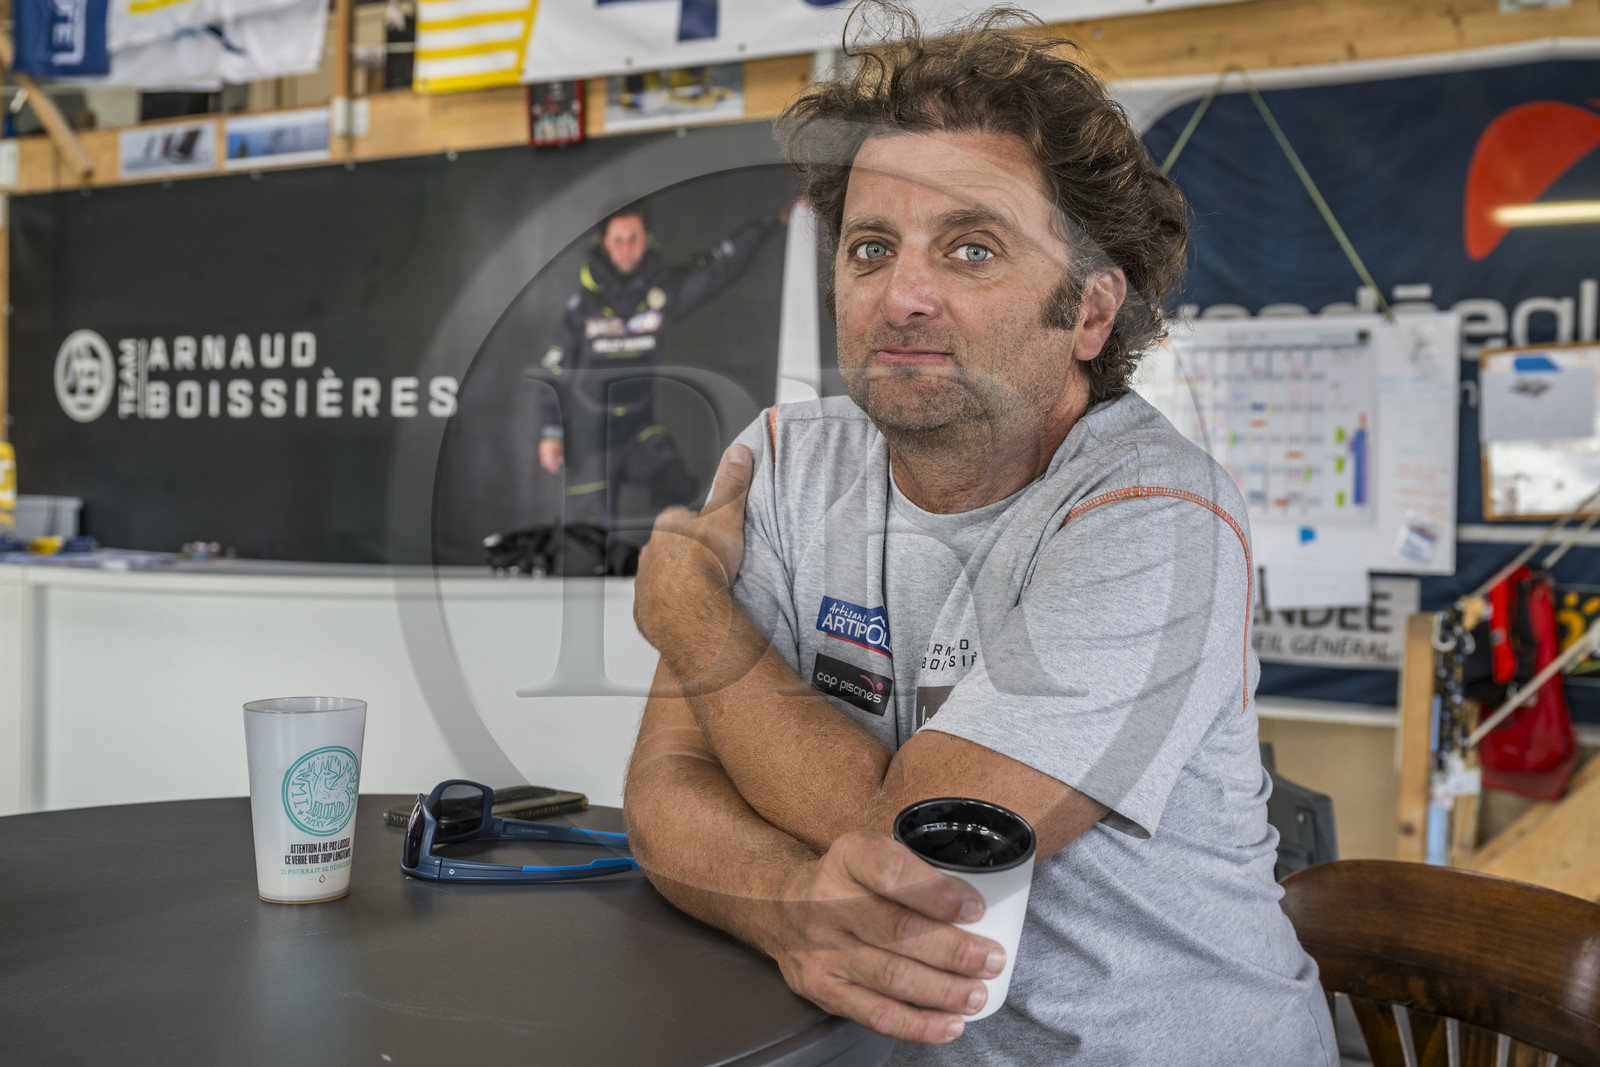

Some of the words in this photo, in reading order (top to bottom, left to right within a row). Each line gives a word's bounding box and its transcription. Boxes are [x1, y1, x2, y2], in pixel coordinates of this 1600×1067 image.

[147, 332, 317, 370] ARNAUD
[118, 338, 138, 419] TEAM
[147, 368, 459, 419] BOISSIÈRES
[829, 602, 867, 622] Artisans
[821, 613, 893, 653] ARTIPÔL
[816, 671, 838, 688] cap
[839, 679, 882, 704] piscines
[284, 855, 291, 865] CE
[291, 854, 308, 865] VERRE
[308, 854, 319, 865] VIDE
[320, 852, 333, 864] TROP
[290, 843, 318, 854] ATTENTION
[322, 842, 328, 852] NE
[329, 840, 338, 851] PAS
[288, 867, 320, 875] POURRAIT
[321, 865, 328, 873] SE
